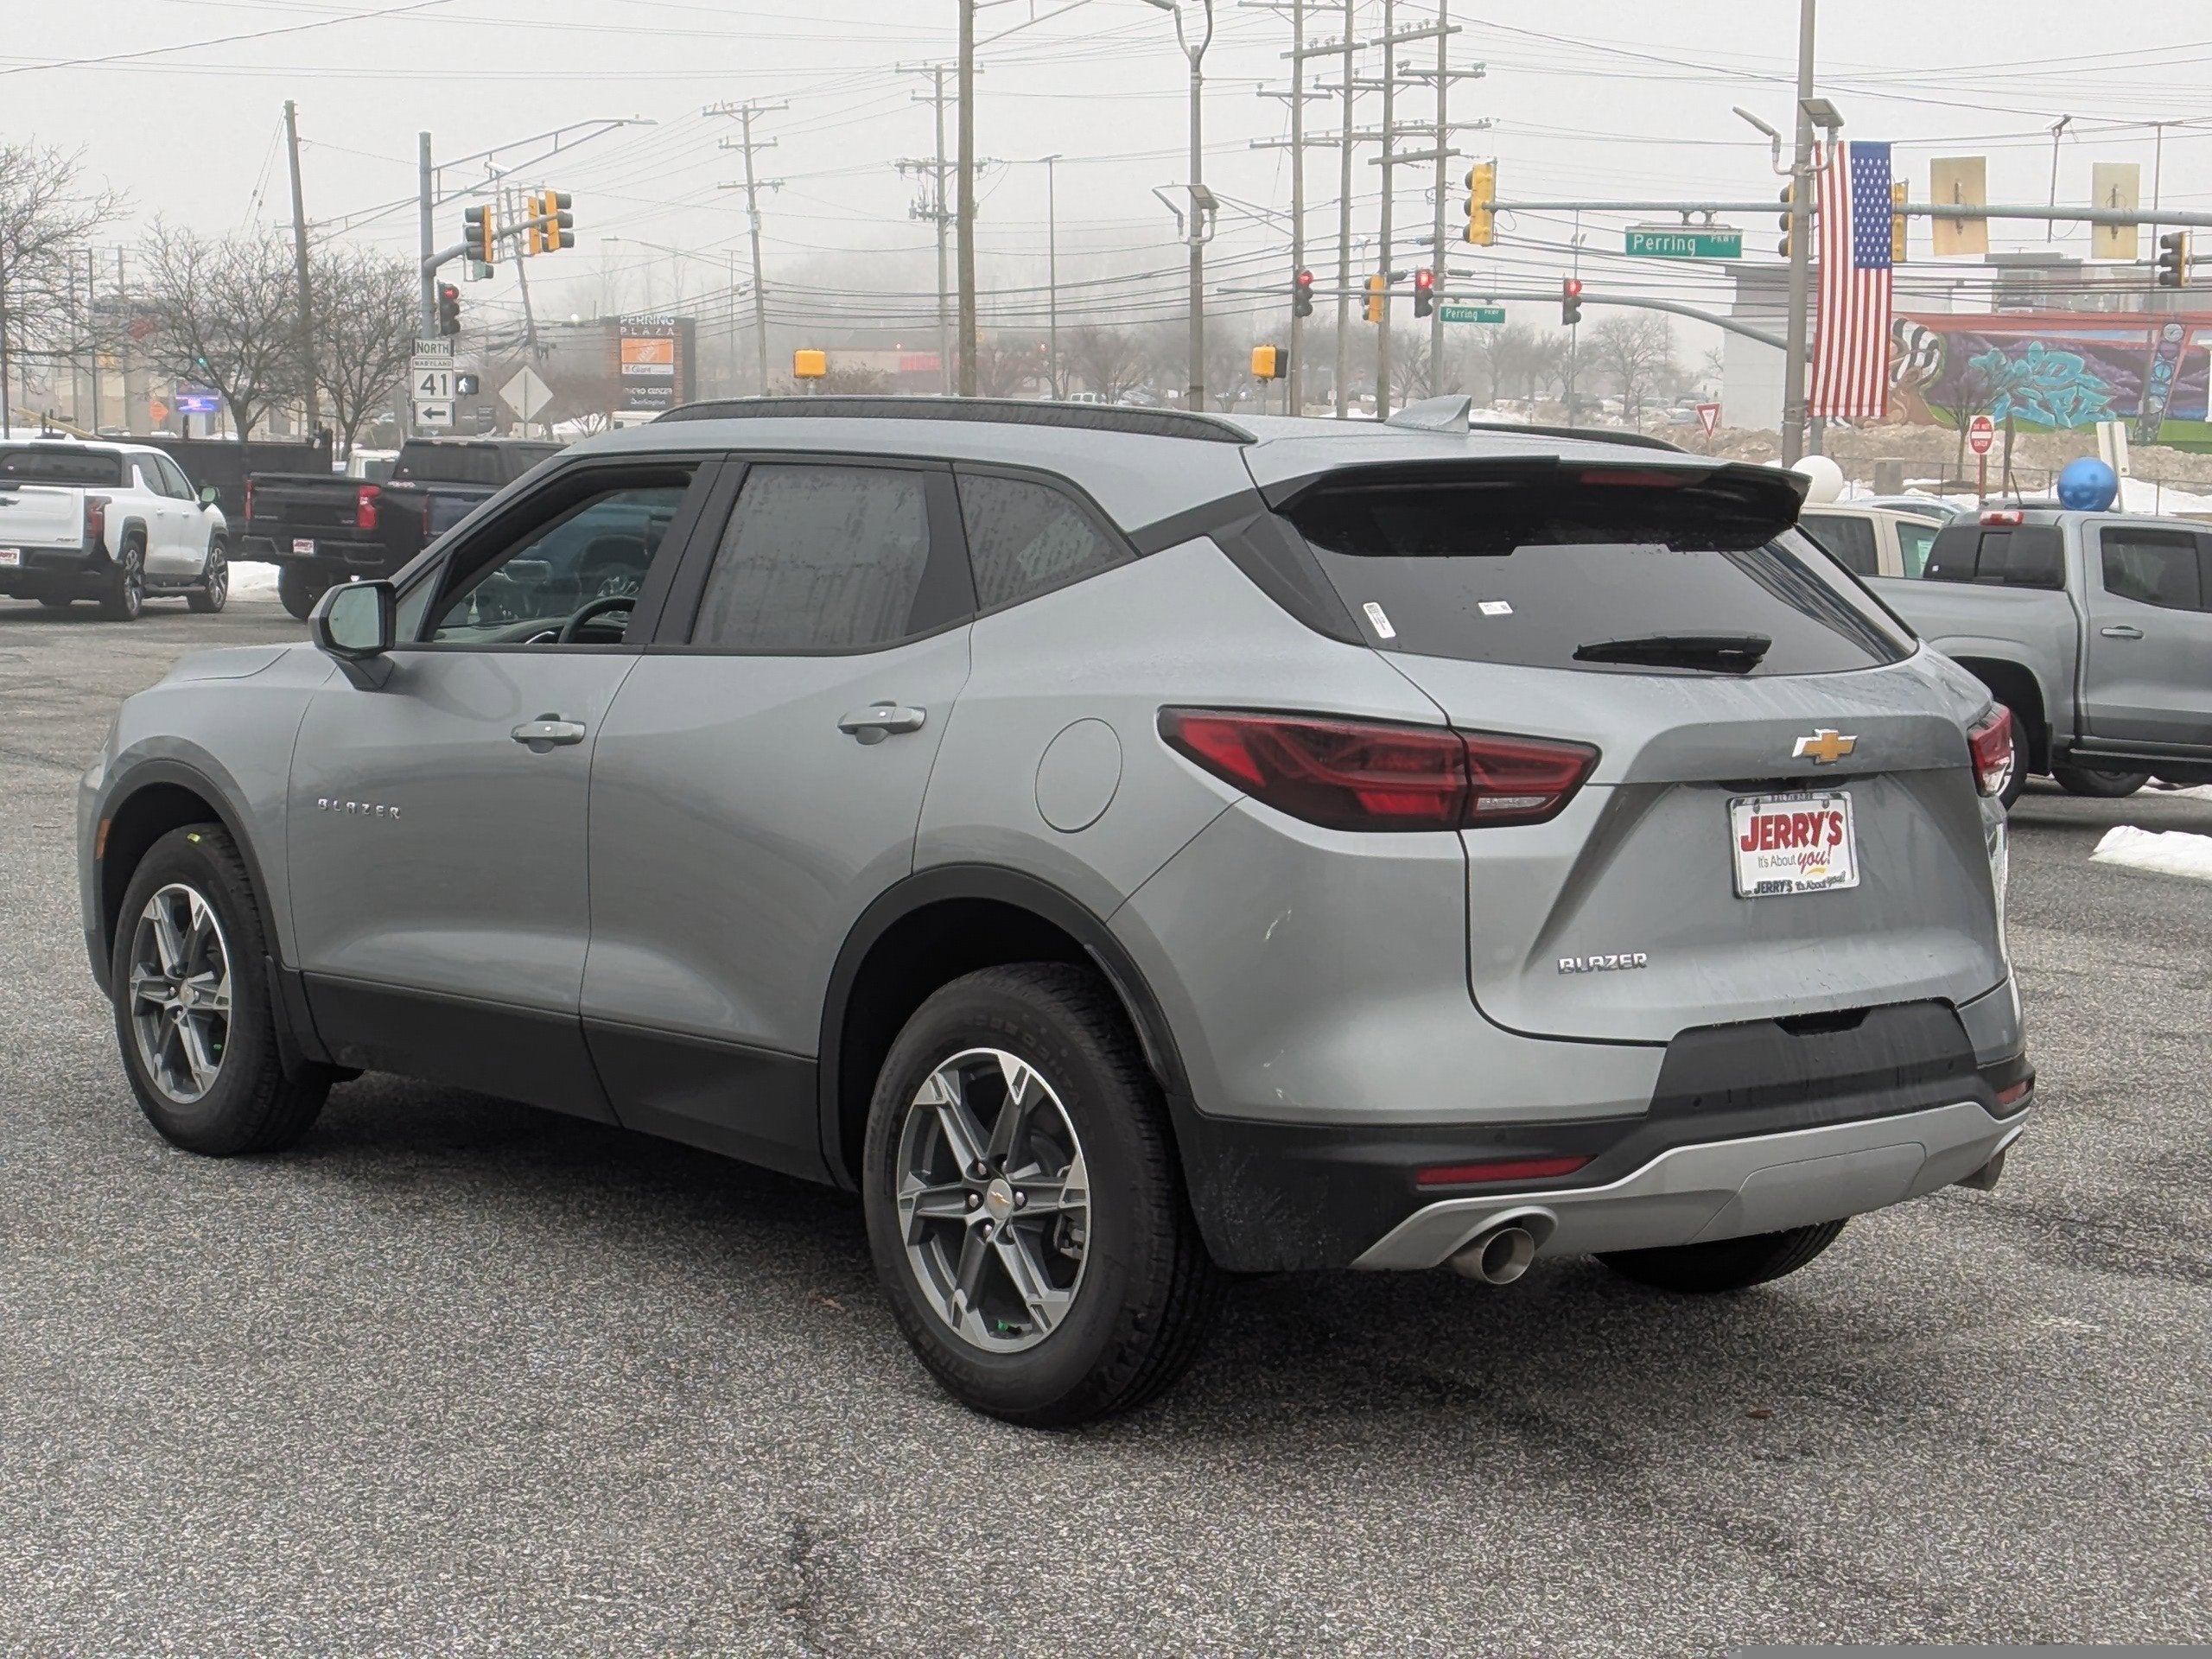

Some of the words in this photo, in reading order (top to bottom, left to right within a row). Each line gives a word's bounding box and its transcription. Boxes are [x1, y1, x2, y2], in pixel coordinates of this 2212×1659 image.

[1633, 233, 1696, 257] Perring
[1446, 308, 1478, 321] Perring
[620, 327, 674, 335] PLAZA
[416, 342, 449, 353] NORTH
[420, 373, 448, 396] 41
[318, 798, 401, 820] BLAZER
[1740, 810, 1844, 853] JERRY'S
[1758, 855, 1770, 868] It's
[1770, 854, 1796, 868] About
[1797, 846, 1832, 875] you!
[1753, 880, 1794, 895] JERRY'S
[1558, 952, 1648, 976] BLAZER
